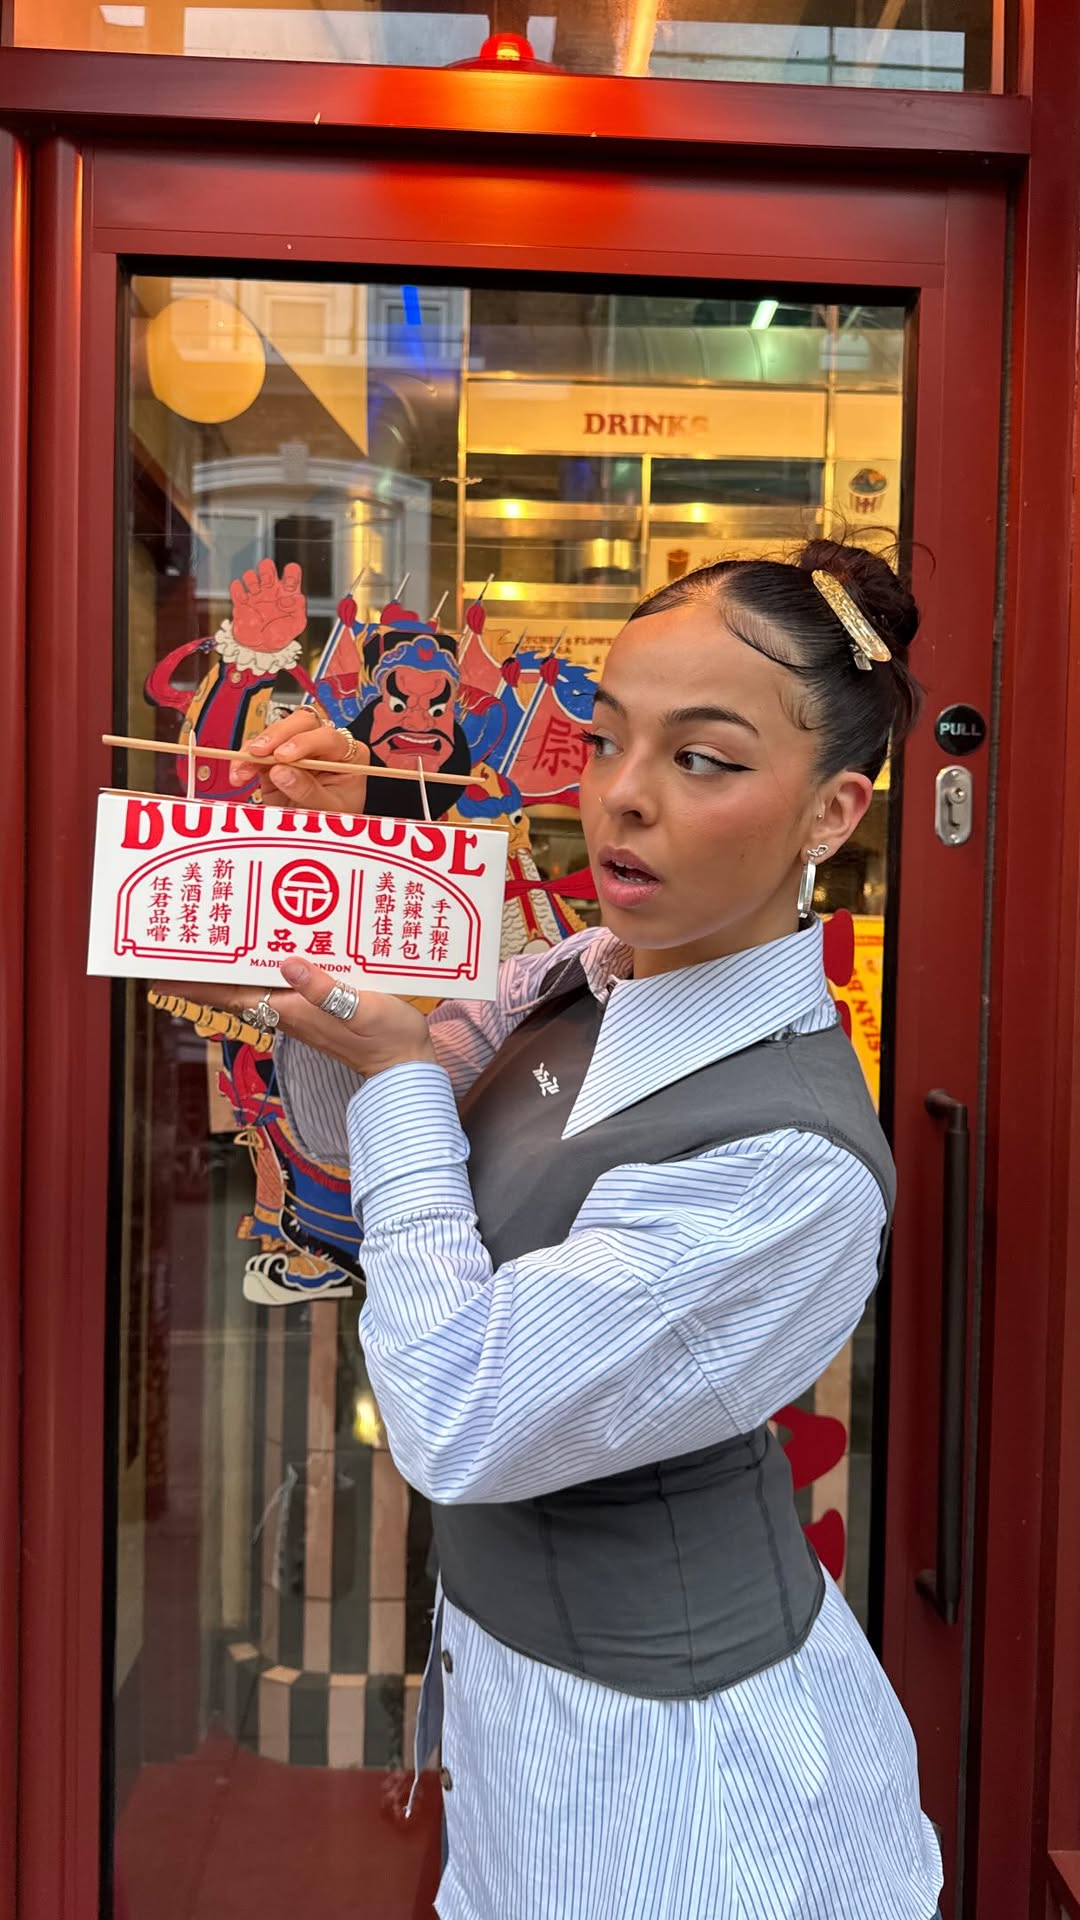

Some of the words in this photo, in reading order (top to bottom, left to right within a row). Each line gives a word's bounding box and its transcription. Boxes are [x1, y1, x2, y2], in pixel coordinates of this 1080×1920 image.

[583, 412, 709, 437] DRINKS
[939, 722, 982, 737] PULL
[177, 862, 203, 943] 美酒茗茶
[208, 857, 235, 946] 新鮮特調
[372, 871, 396, 957] 美點佳餚
[399, 880, 425, 960] 熱辣鮮包
[427, 898, 451, 962] 手工製作
[250, 958, 283, 968] MADE
[312, 962, 352, 973] NDON
[267, 928, 336, 956] 品屋
